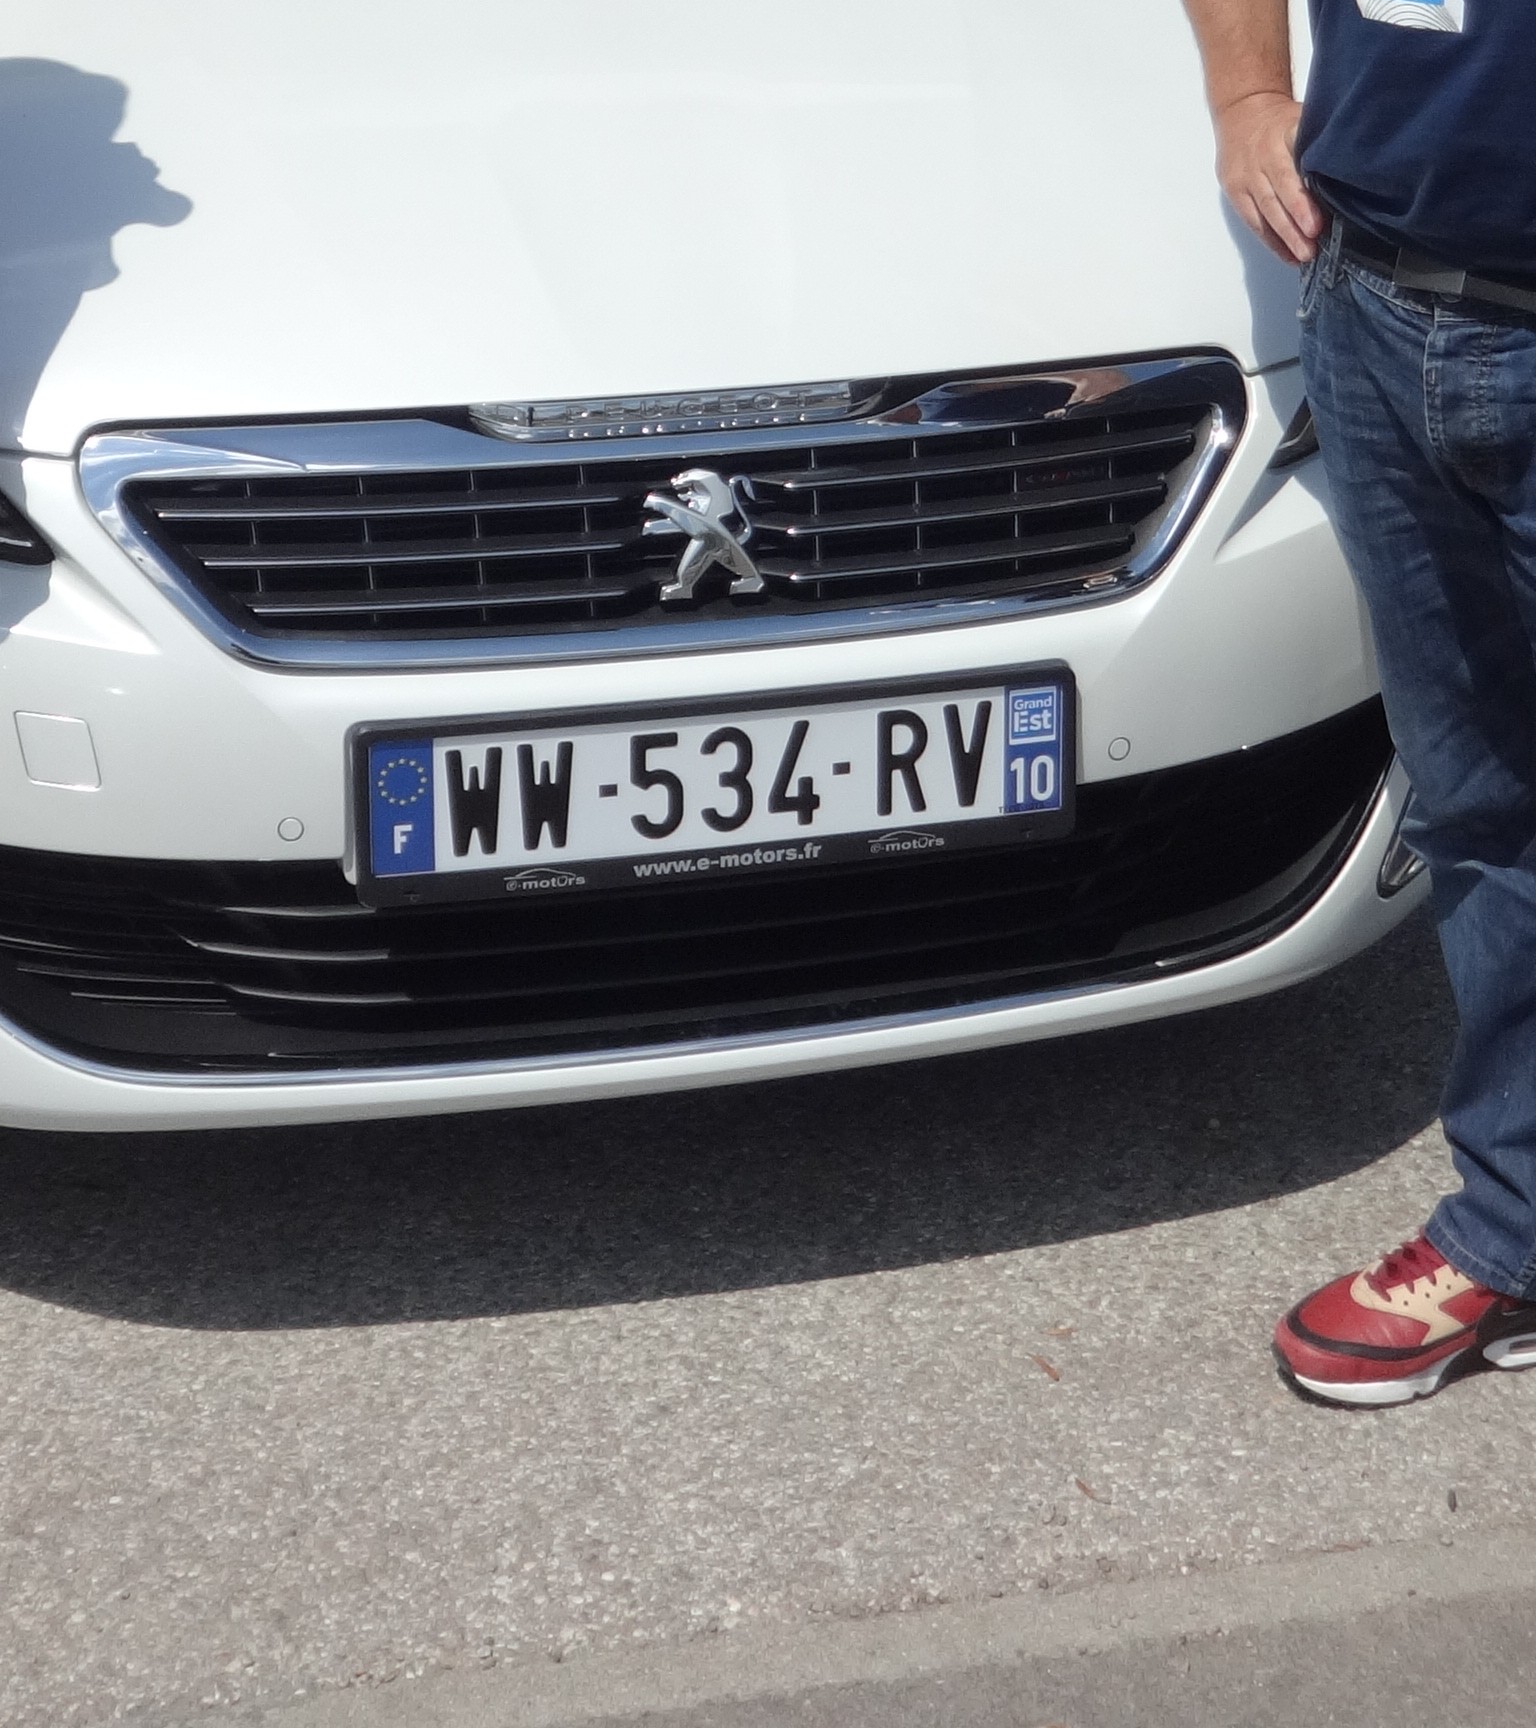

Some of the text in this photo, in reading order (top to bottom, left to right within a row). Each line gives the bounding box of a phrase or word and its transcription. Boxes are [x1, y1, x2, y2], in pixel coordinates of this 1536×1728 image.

[566, 388, 812, 420] PEUGEOT
[1013, 696, 1052, 711] Grand
[1013, 709, 1052, 732] Est
[393, 823, 413, 854] F
[1010, 755, 1054, 803] 10
[633, 842, 821, 877] www.e-motors.fr
